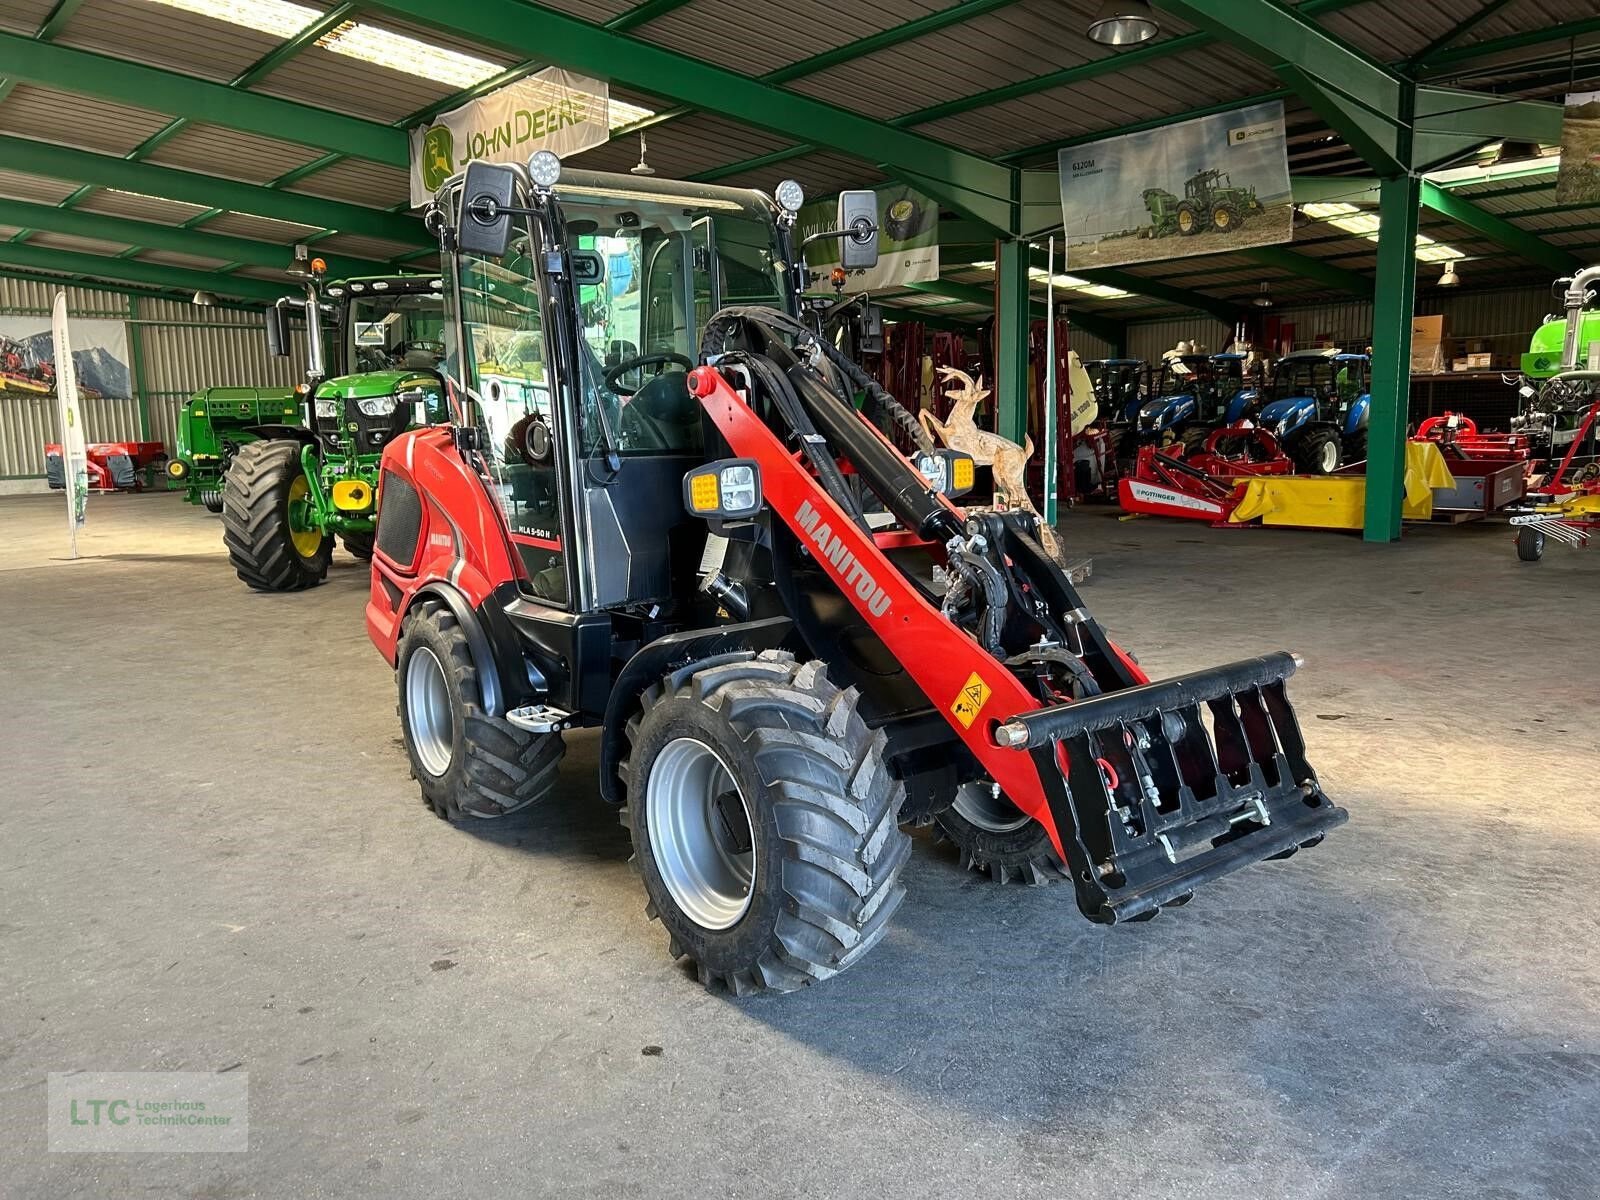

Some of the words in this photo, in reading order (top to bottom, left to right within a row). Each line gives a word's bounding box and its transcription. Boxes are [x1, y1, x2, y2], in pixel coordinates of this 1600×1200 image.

[459, 121, 512, 166] JOHN
[514, 94, 587, 144] DEERE
[1072, 159, 1095, 171] 6120M
[794, 499, 892, 617] MANITOU
